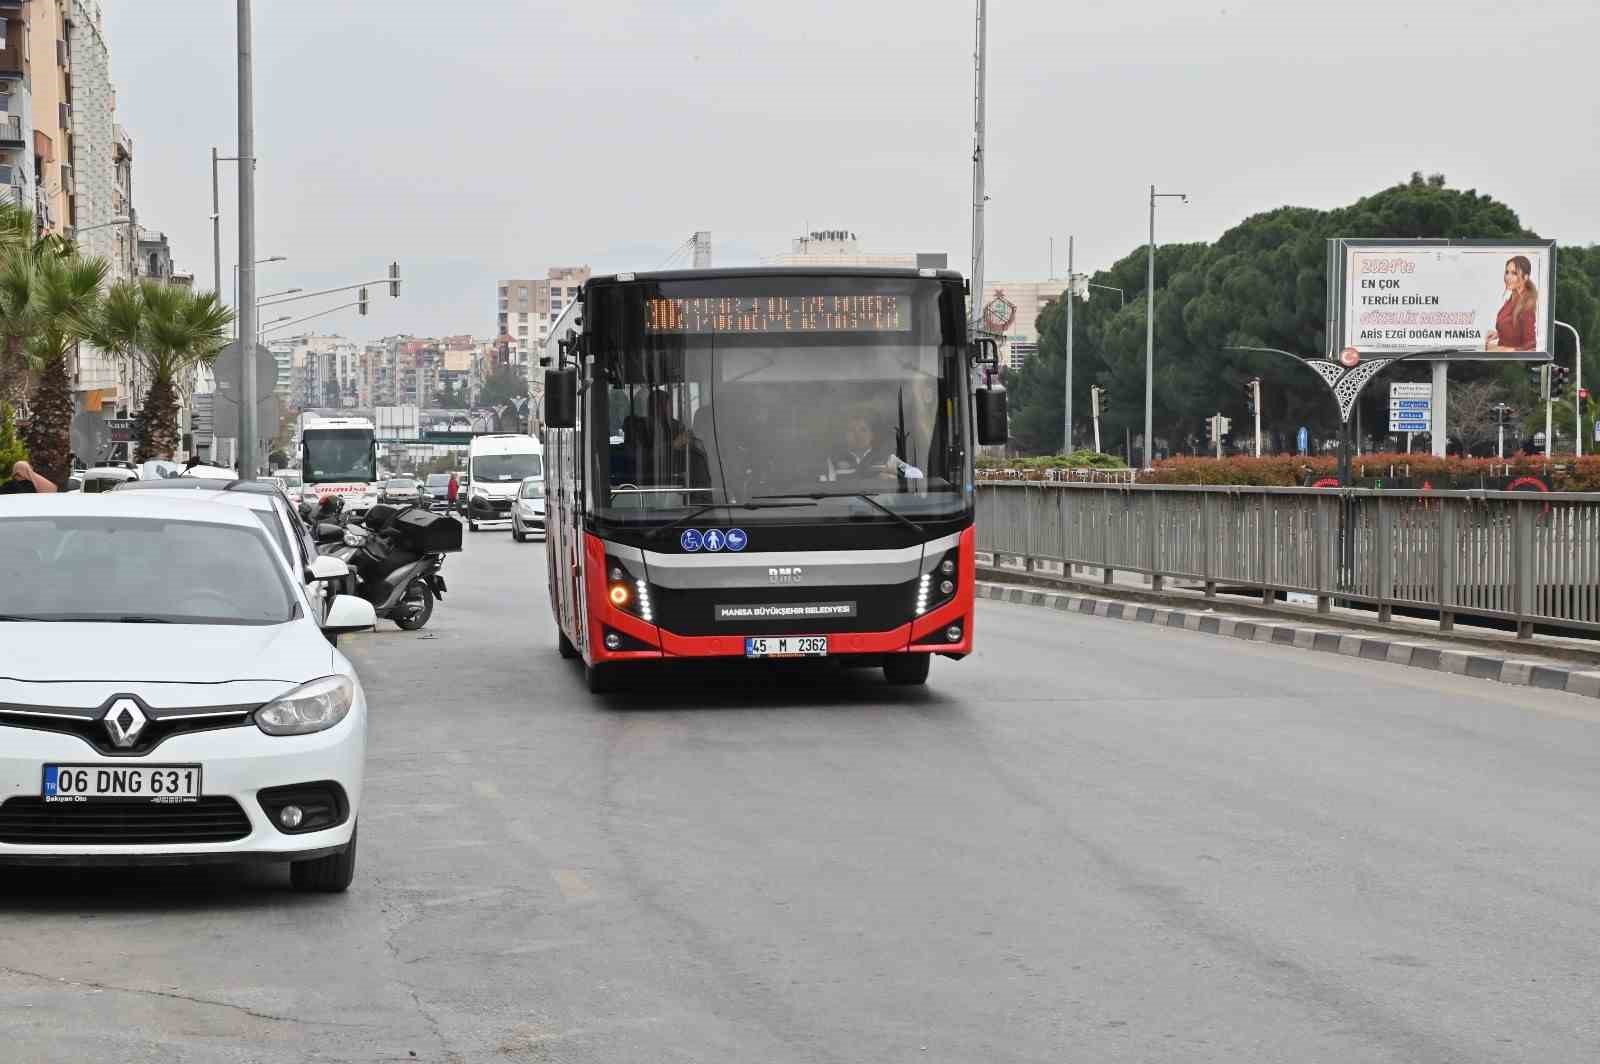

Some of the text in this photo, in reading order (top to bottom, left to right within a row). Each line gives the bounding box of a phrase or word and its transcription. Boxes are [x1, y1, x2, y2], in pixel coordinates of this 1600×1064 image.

[1361, 280, 1400, 291] EN ÇOK
[1361, 294, 1439, 305] TERCİH EDİLEN
[1360, 328, 1481, 339] ARİS EZGİ DOĞAN MANİSA
[752, 638, 826, 653] 45 M 2362
[59, 770, 88, 793] 06
[97, 770, 142, 794] DNG
[150, 771, 192, 795] 631
